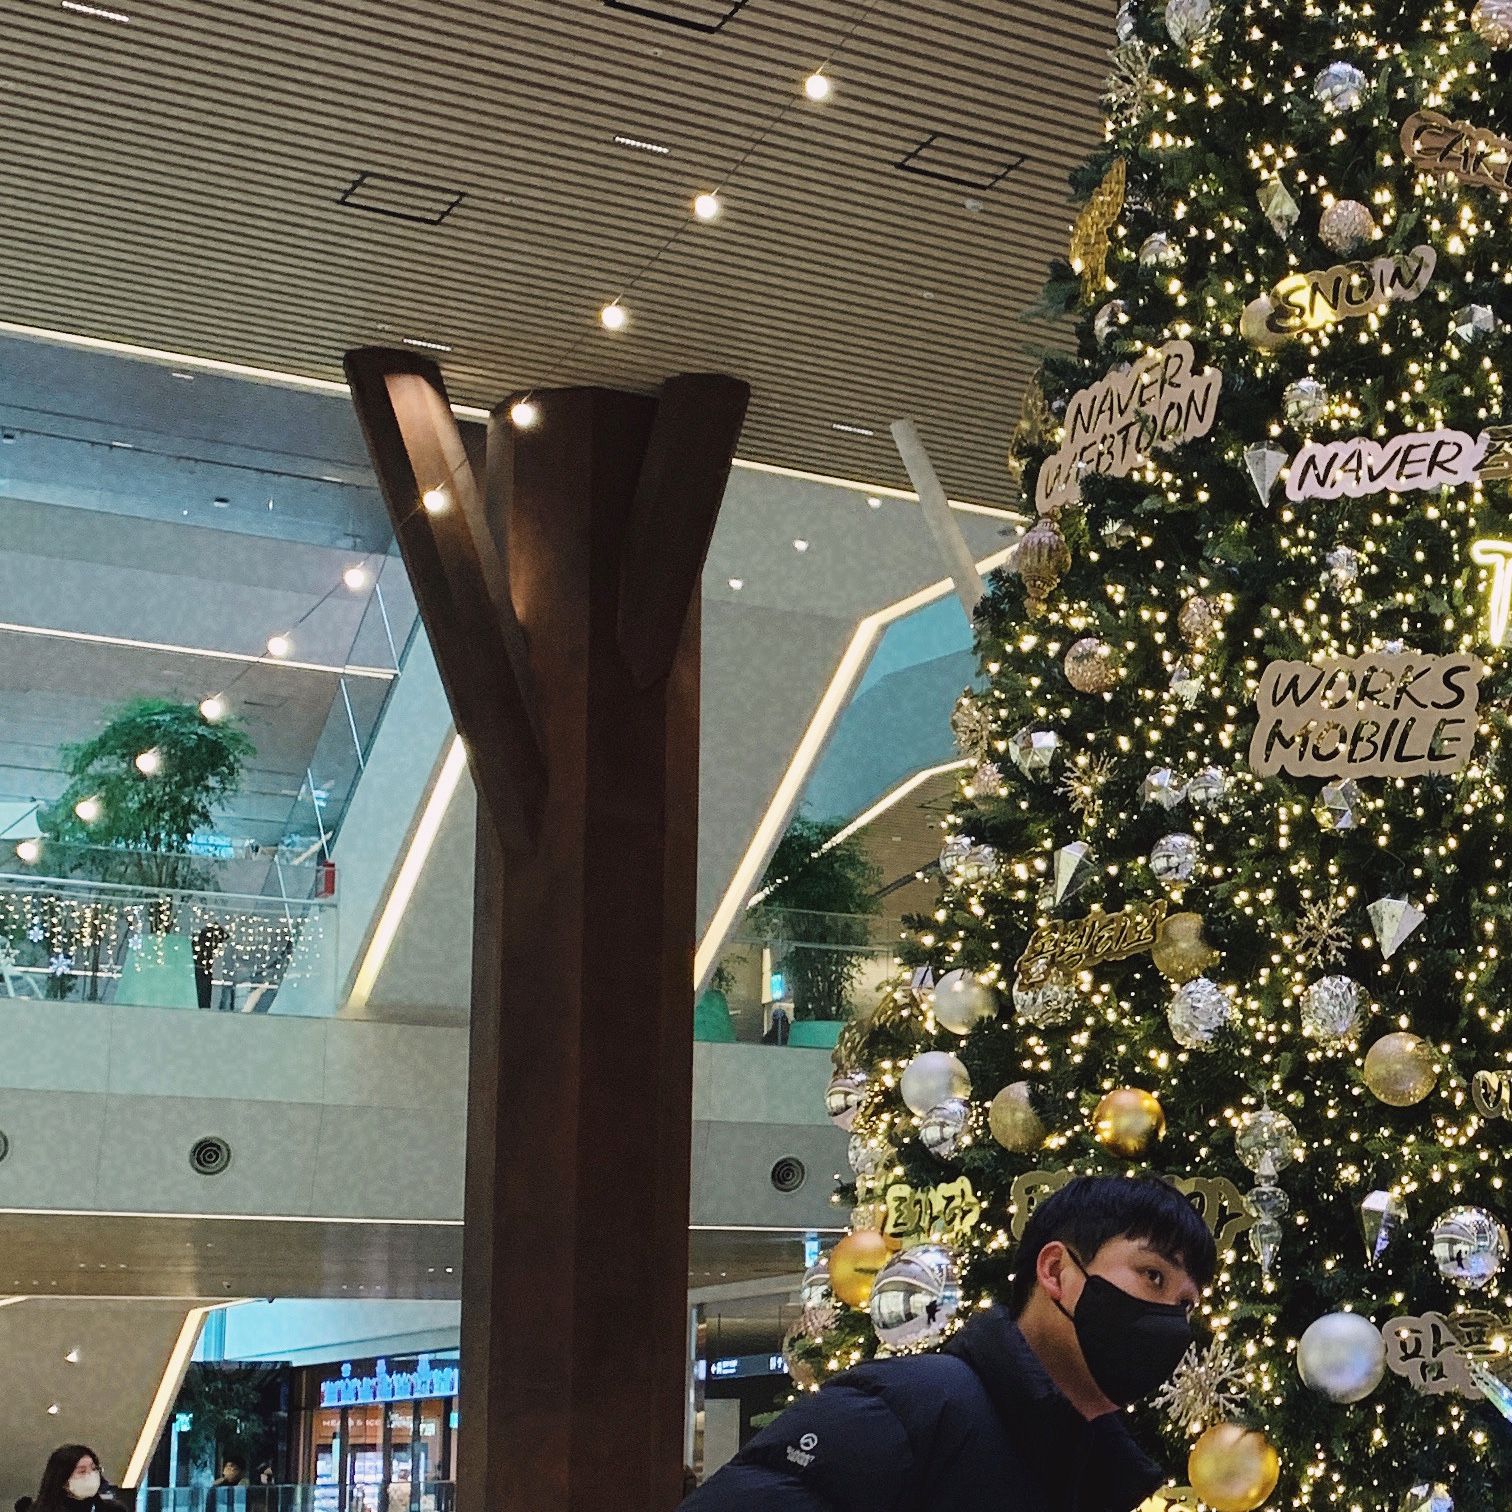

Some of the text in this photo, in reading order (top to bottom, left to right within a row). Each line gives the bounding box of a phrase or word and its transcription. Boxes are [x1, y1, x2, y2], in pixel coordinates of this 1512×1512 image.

[1265, 255, 1425, 334] SNOW
[1070, 353, 1184, 444] NAVER
[1297, 439, 1463, 491] NAVER
[1271, 664, 1471, 711] WORKS
[1263, 716, 1466, 764] MOBILE
